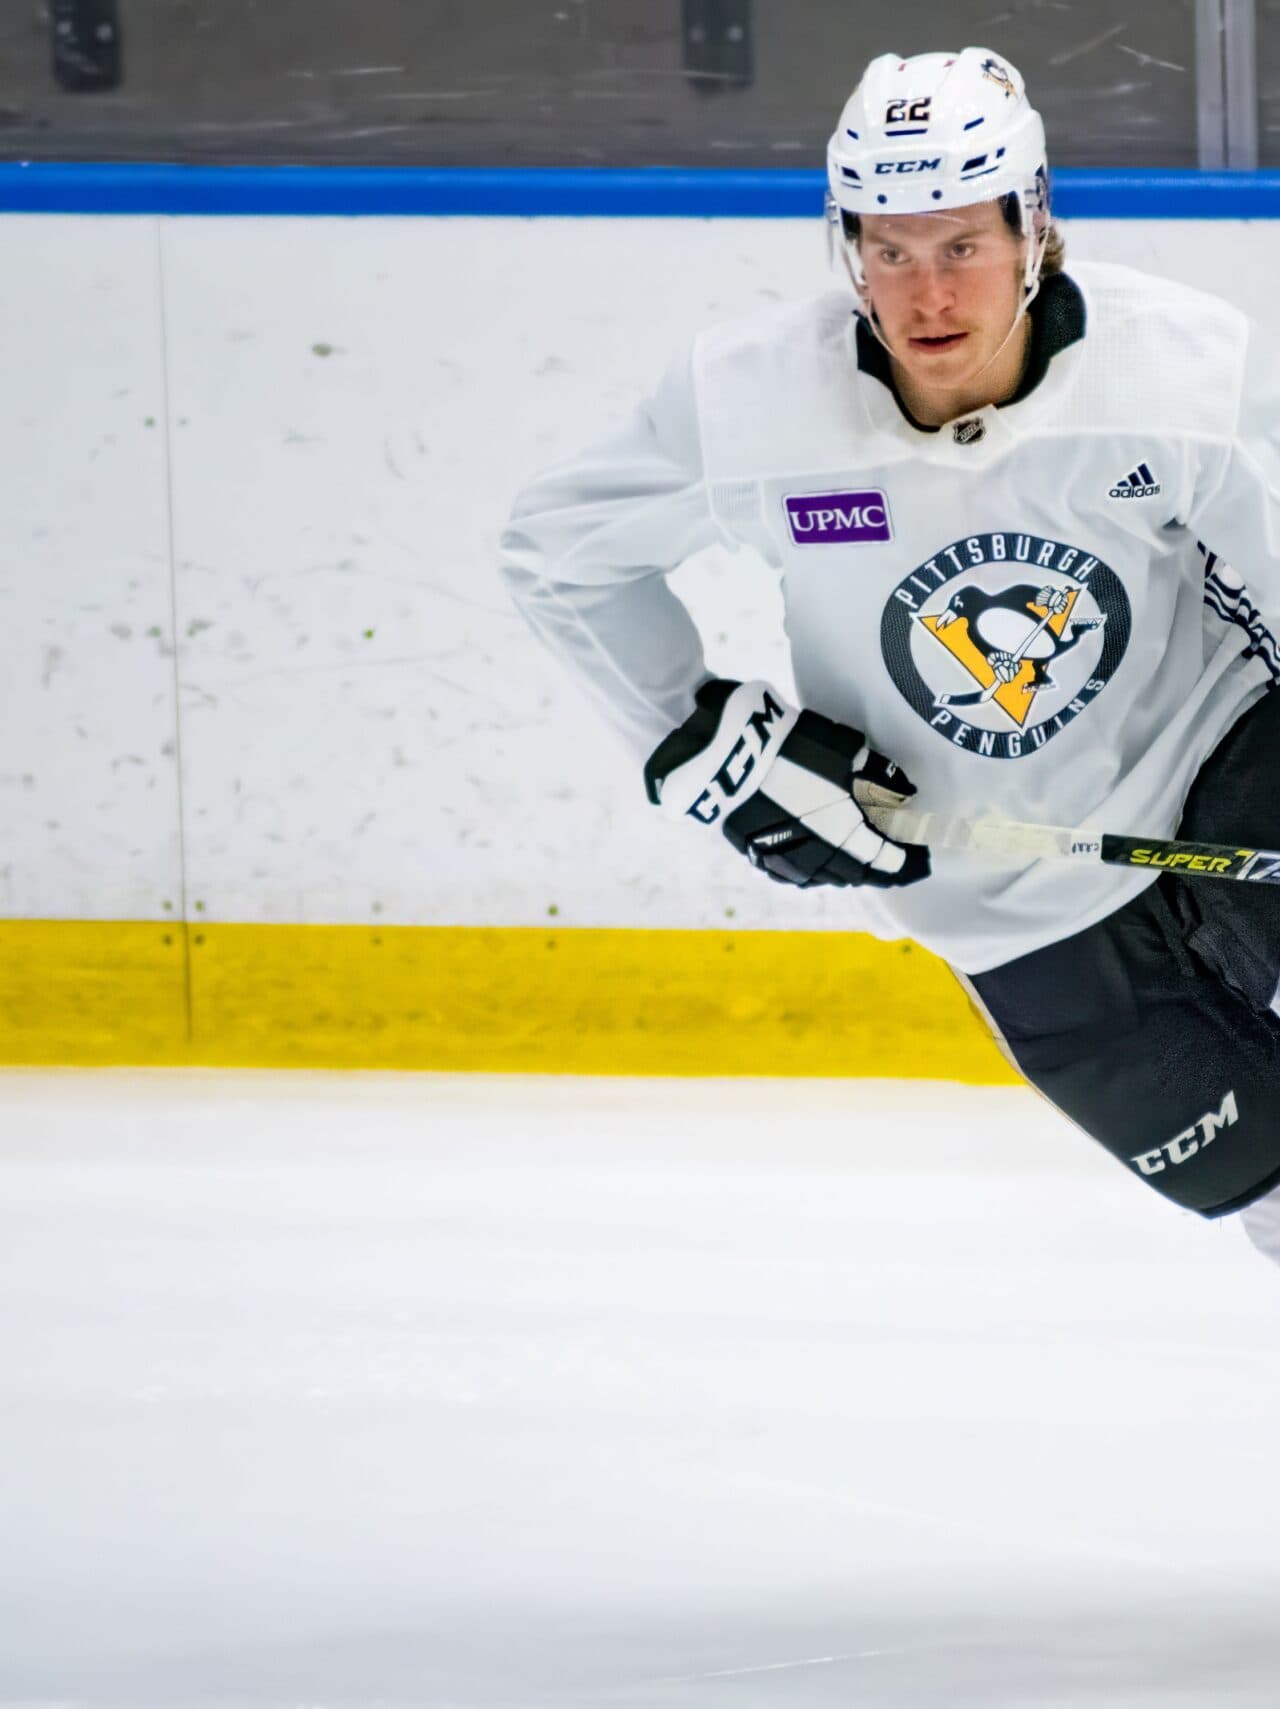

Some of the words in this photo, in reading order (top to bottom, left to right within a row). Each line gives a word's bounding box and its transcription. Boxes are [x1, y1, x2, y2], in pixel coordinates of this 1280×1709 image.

[885, 97, 932, 124] 22
[874, 157, 941, 175] CCM
[1109, 484, 1160, 498] adidas
[790, 506, 887, 532] UPMC
[895, 534, 1098, 609] PITTSBURGH
[931, 678, 1105, 758] PENGUINS
[685, 690, 785, 824] CCM
[1130, 849, 1232, 873] SUPER
[1130, 1090, 1239, 1175] CCM
